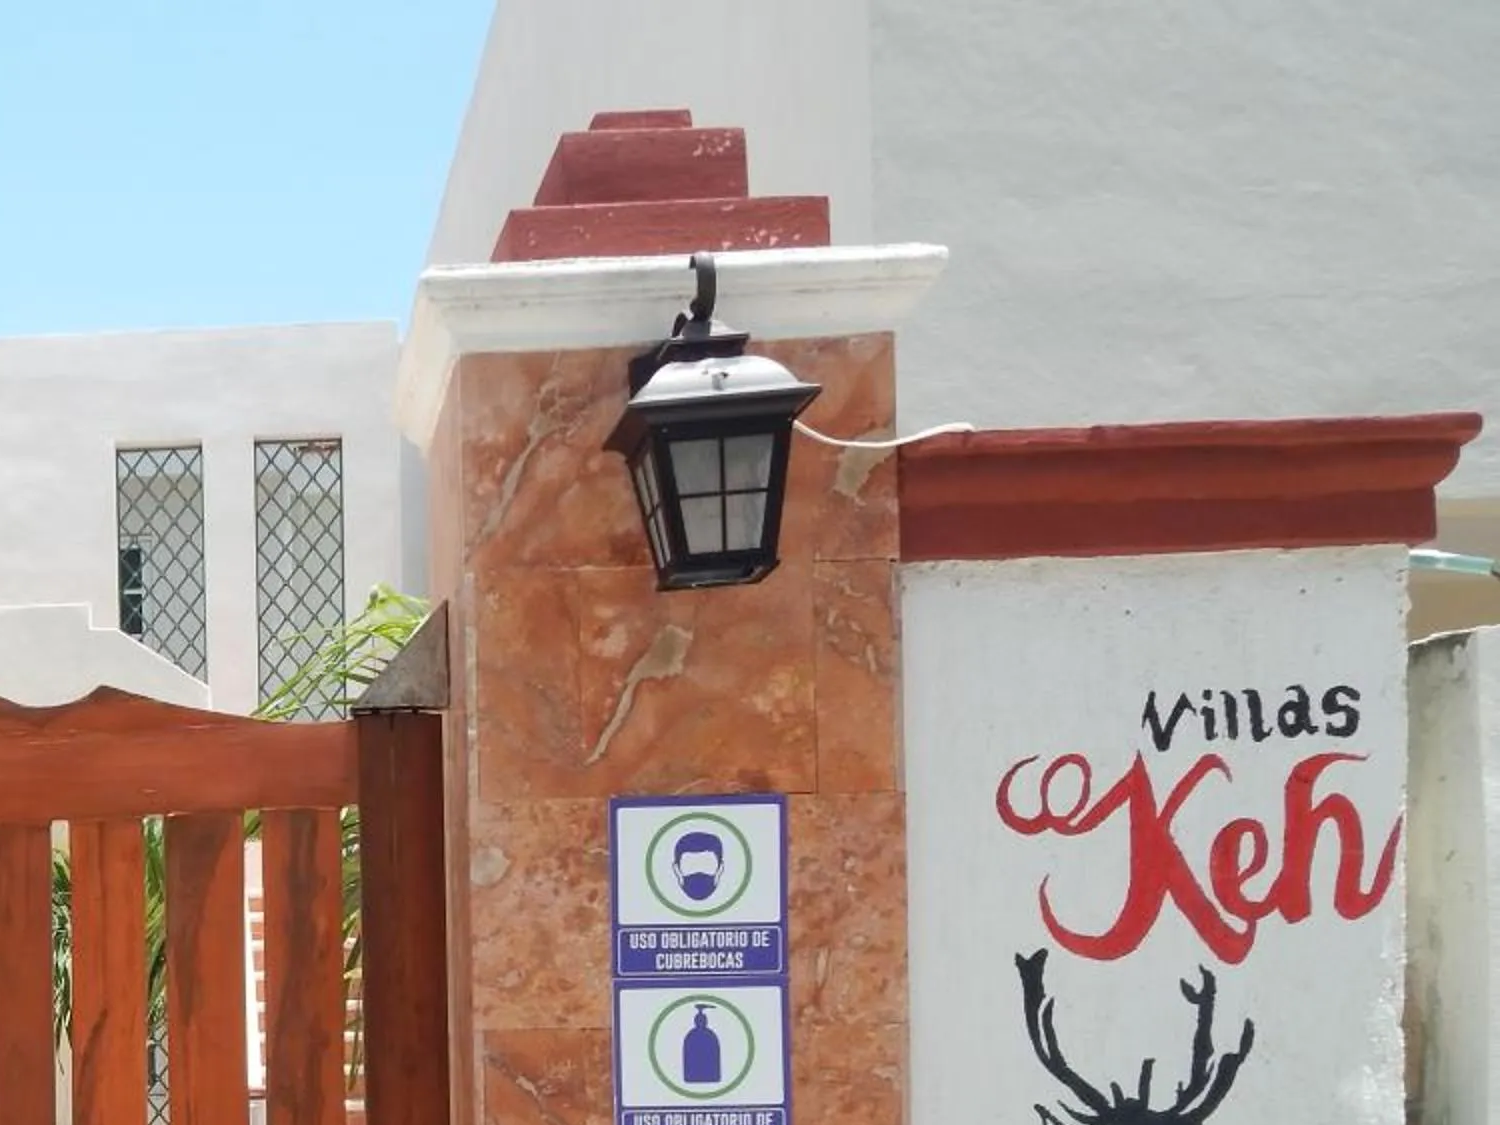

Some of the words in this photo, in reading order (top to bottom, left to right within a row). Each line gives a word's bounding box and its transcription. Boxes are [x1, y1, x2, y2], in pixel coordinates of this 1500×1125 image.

[629, 932, 657, 949] USO
[661, 930, 748, 949] OBLIGATORIO
[752, 930, 770, 947] DE
[655, 951, 744, 970] CUBREBOCAS
